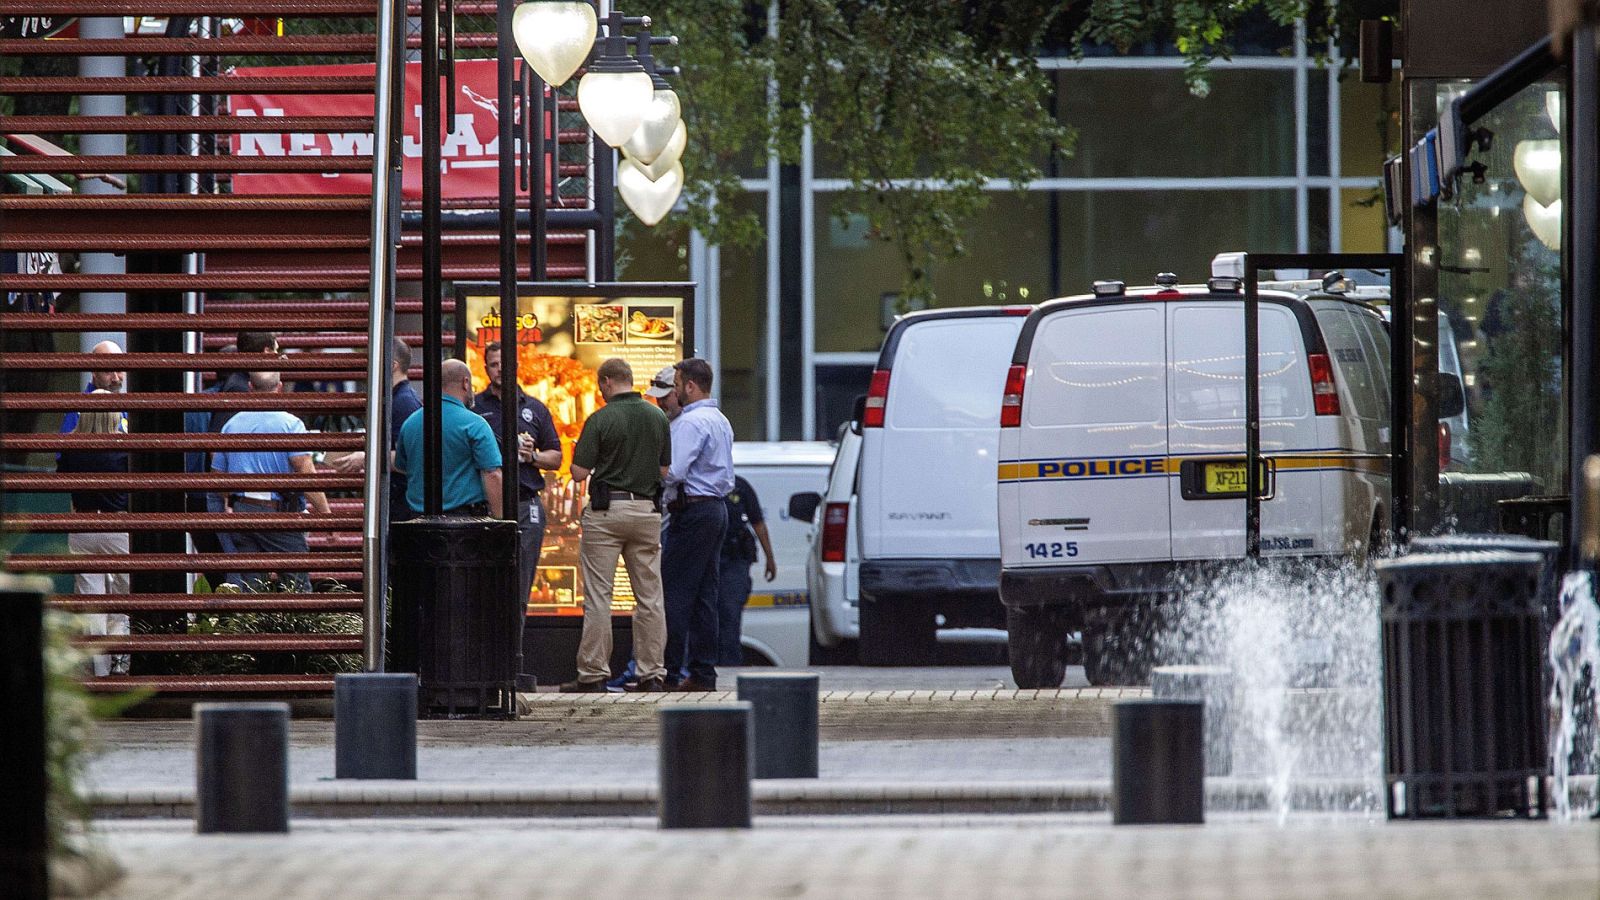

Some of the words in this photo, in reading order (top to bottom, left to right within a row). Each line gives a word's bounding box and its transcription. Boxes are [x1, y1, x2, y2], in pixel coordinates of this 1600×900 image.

[481, 312, 539, 331] chigo
[1037, 458, 1164, 478] POLICE
[1215, 470, 1247, 486] XF211
[1025, 541, 1079, 559] 1425
